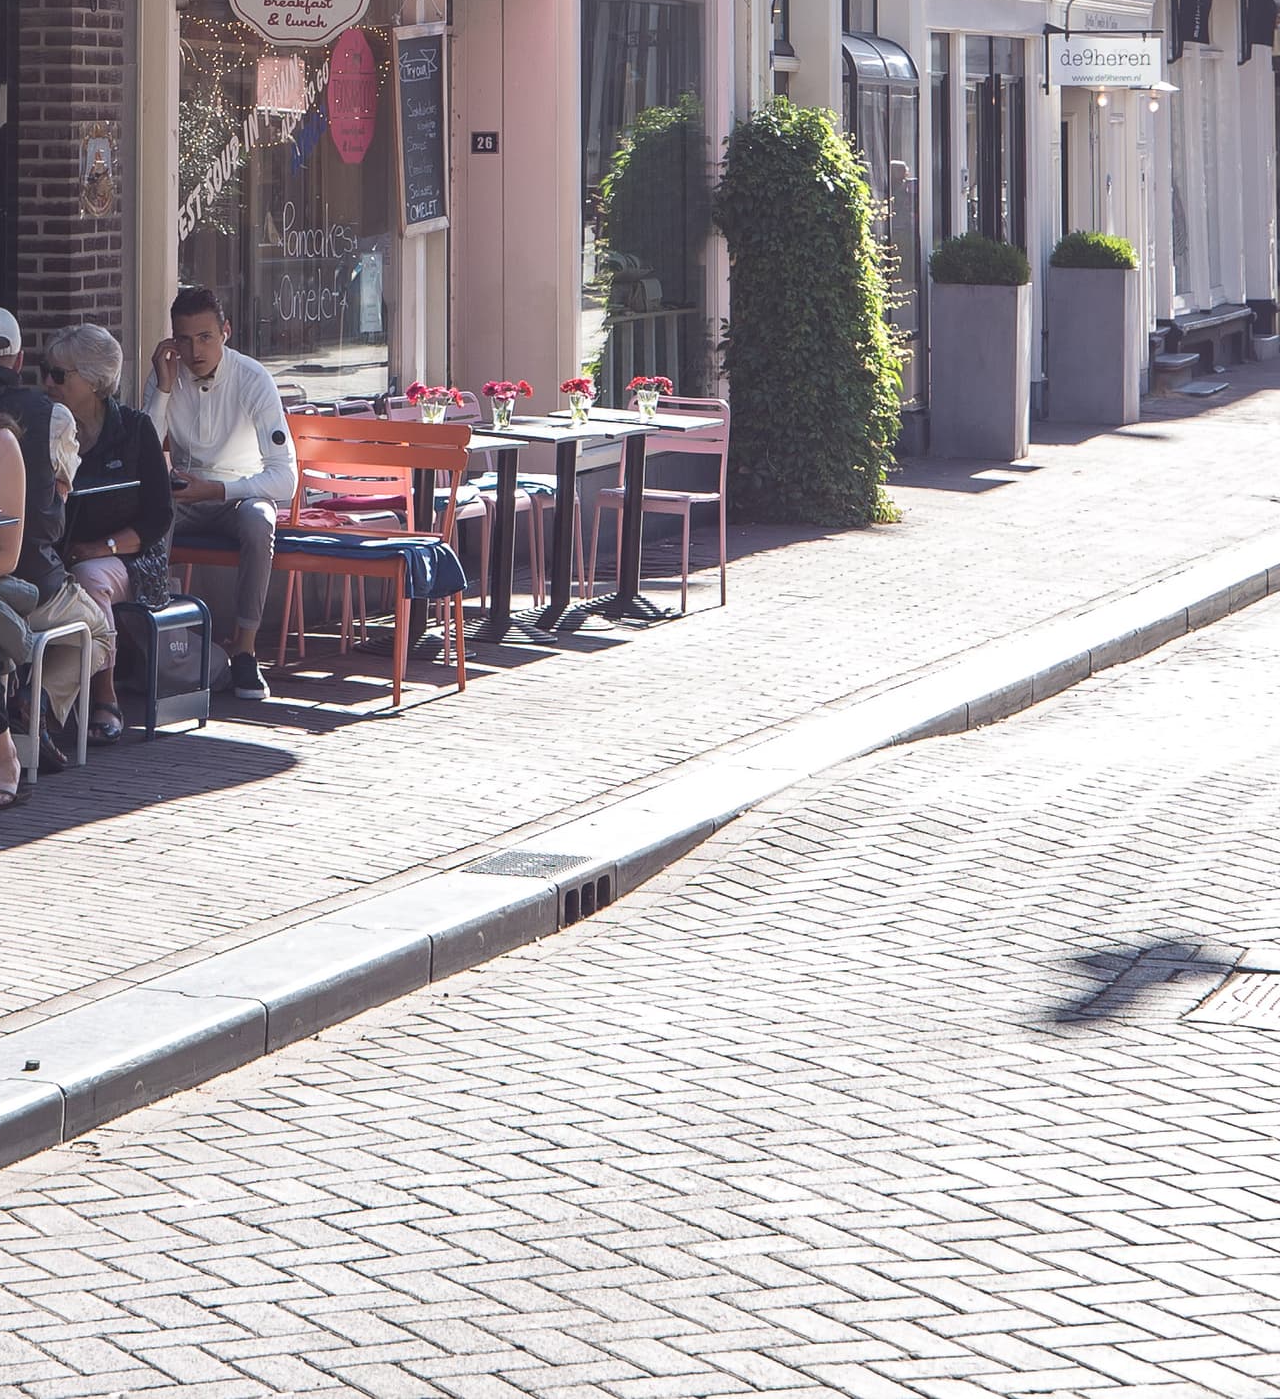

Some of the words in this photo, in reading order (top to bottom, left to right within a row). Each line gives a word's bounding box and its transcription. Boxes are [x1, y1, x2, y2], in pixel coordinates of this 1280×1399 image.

[267, 13, 279, 26] &
[285, 13, 328, 28] lunch
[1060, 48, 1151, 67] de9heren
[1071, 73, 1142, 82] www.de9heren.nl
[477, 136, 493, 150] 26
[177, 183, 201, 246] EST
[206, 134, 240, 205] SOUP
[242, 109, 260, 153] IN
[409, 199, 438, 222] OMELET
[282, 201, 354, 258] Pancakes
